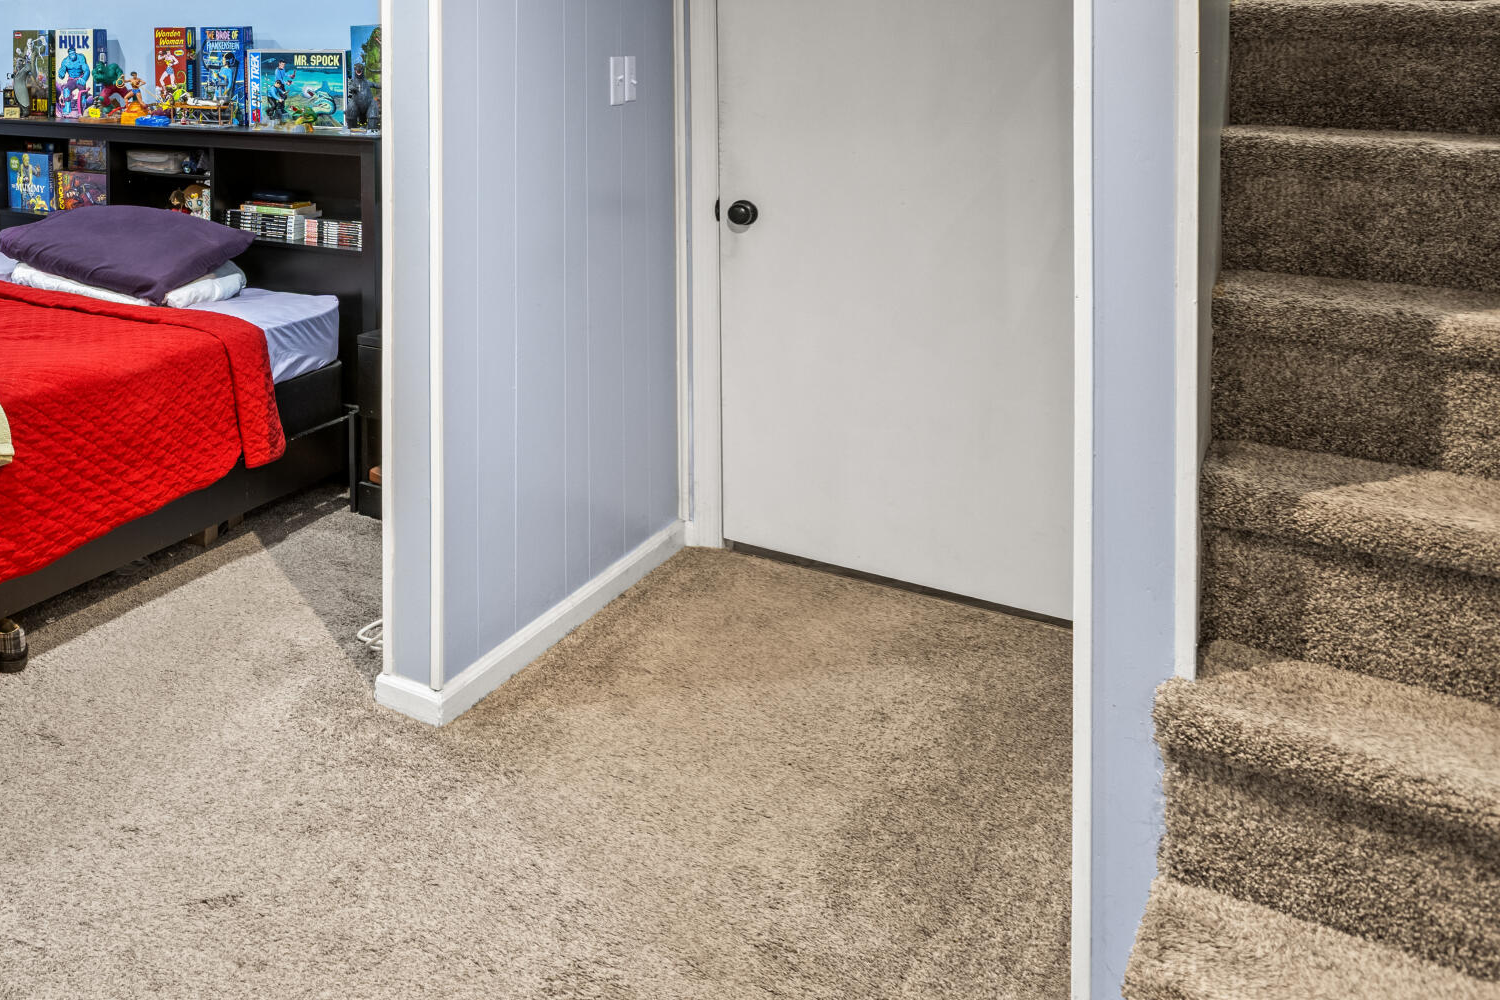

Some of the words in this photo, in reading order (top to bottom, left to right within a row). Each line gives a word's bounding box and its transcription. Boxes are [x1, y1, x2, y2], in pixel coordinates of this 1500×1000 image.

[155, 30, 181, 38] Wonder
[205, 30, 215, 39] THE
[215, 30, 230, 40] BRIDE
[231, 30, 239, 39] OF
[59, 35, 89, 49] HULK
[206, 41, 240, 51] FRANKENSTEIN
[294, 55, 309, 66] MR.
[311, 55, 340, 66] SPOCK
[251, 54, 260, 80] TREK
[15, 183, 46, 194] MUMMY
